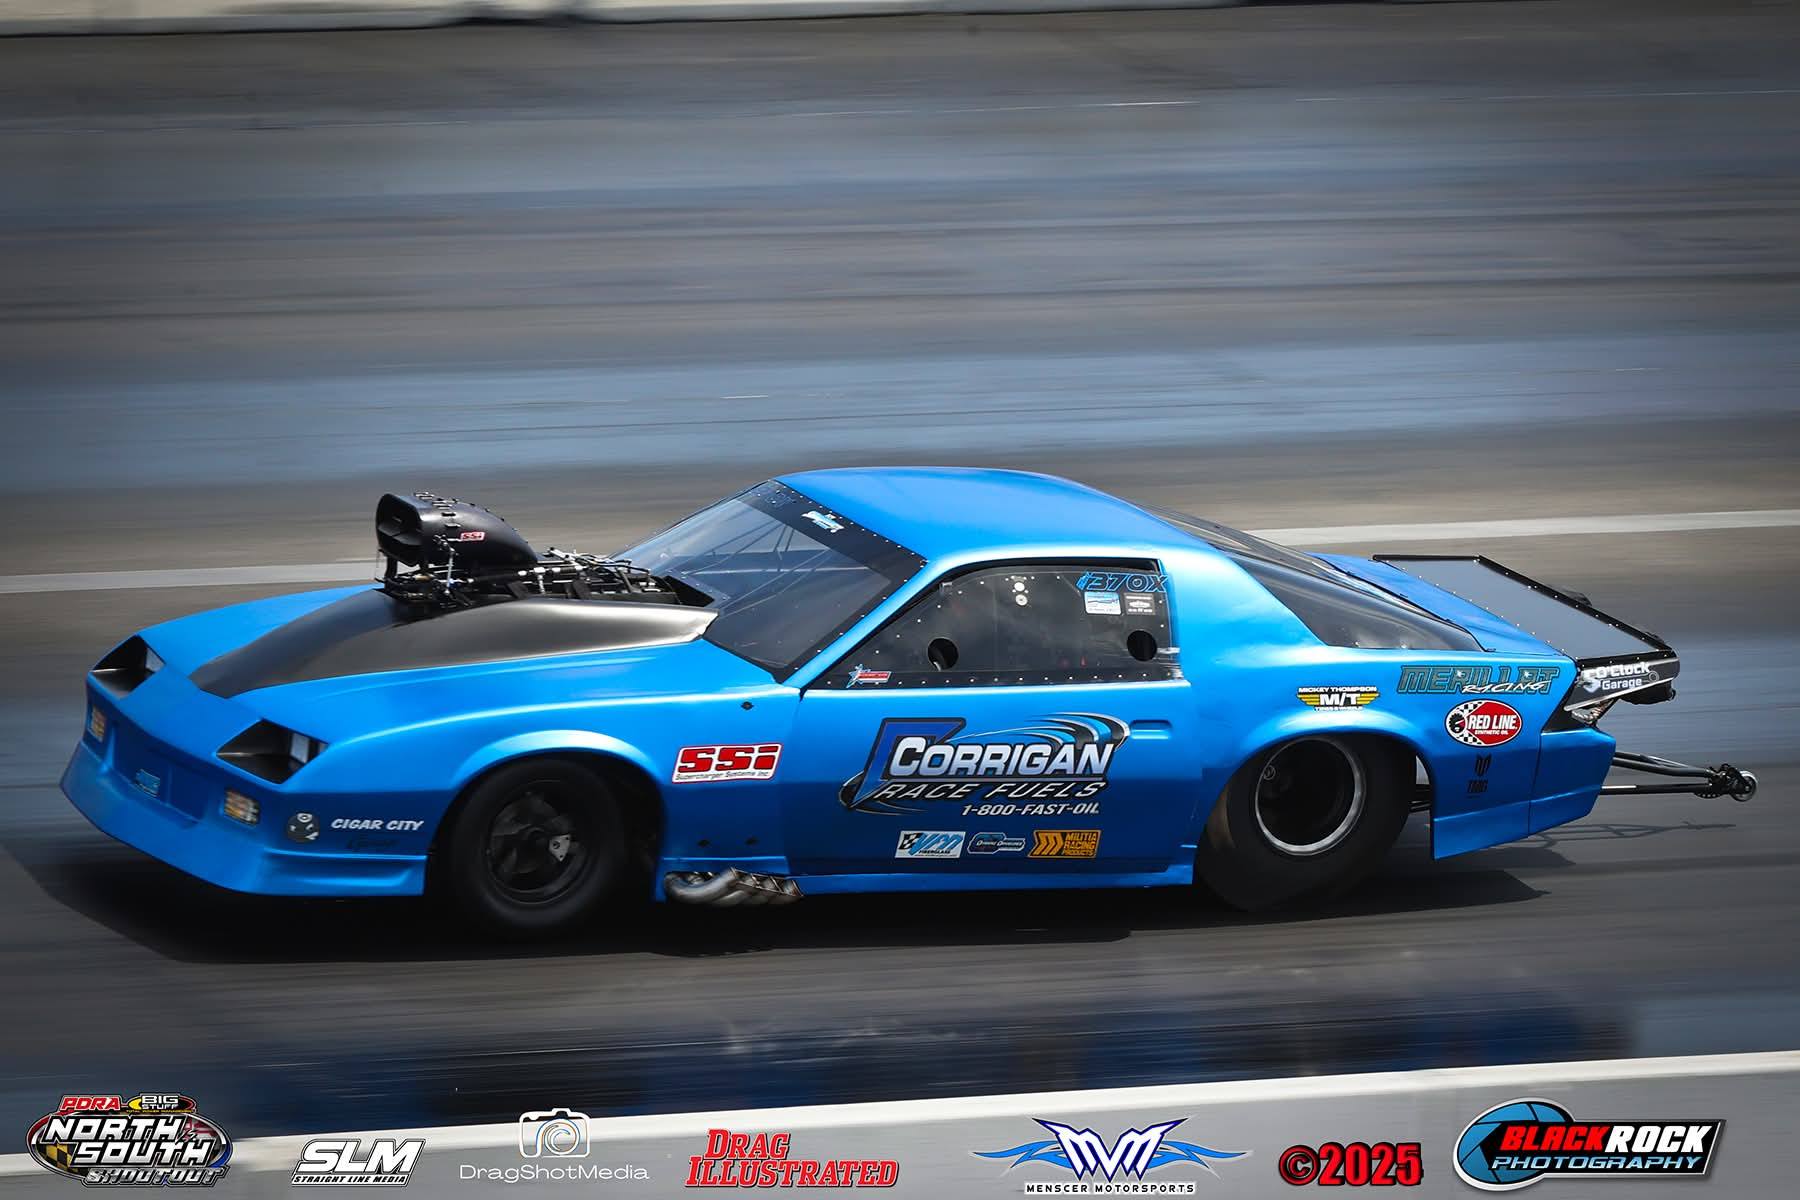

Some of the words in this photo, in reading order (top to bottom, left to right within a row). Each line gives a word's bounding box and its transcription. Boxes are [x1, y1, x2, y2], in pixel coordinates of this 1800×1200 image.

[1461, 680, 1551, 694] RACING
[1602, 678, 1642, 690] Garage
[1320, 693, 1361, 706] M/T
[1467, 715, 1491, 730] RED
[889, 737, 1114, 776] CORRIGAN
[874, 783, 979, 799] RACE
[985, 781, 1105, 798] FUELS
[962, 803, 1100, 816] 1-800-FAST-OIL
[331, 818, 383, 830] CIGAR
[386, 820, 424, 831] CITY
[1066, 832, 1097, 842] MILITIA
[1064, 841, 1096, 850] RACING
